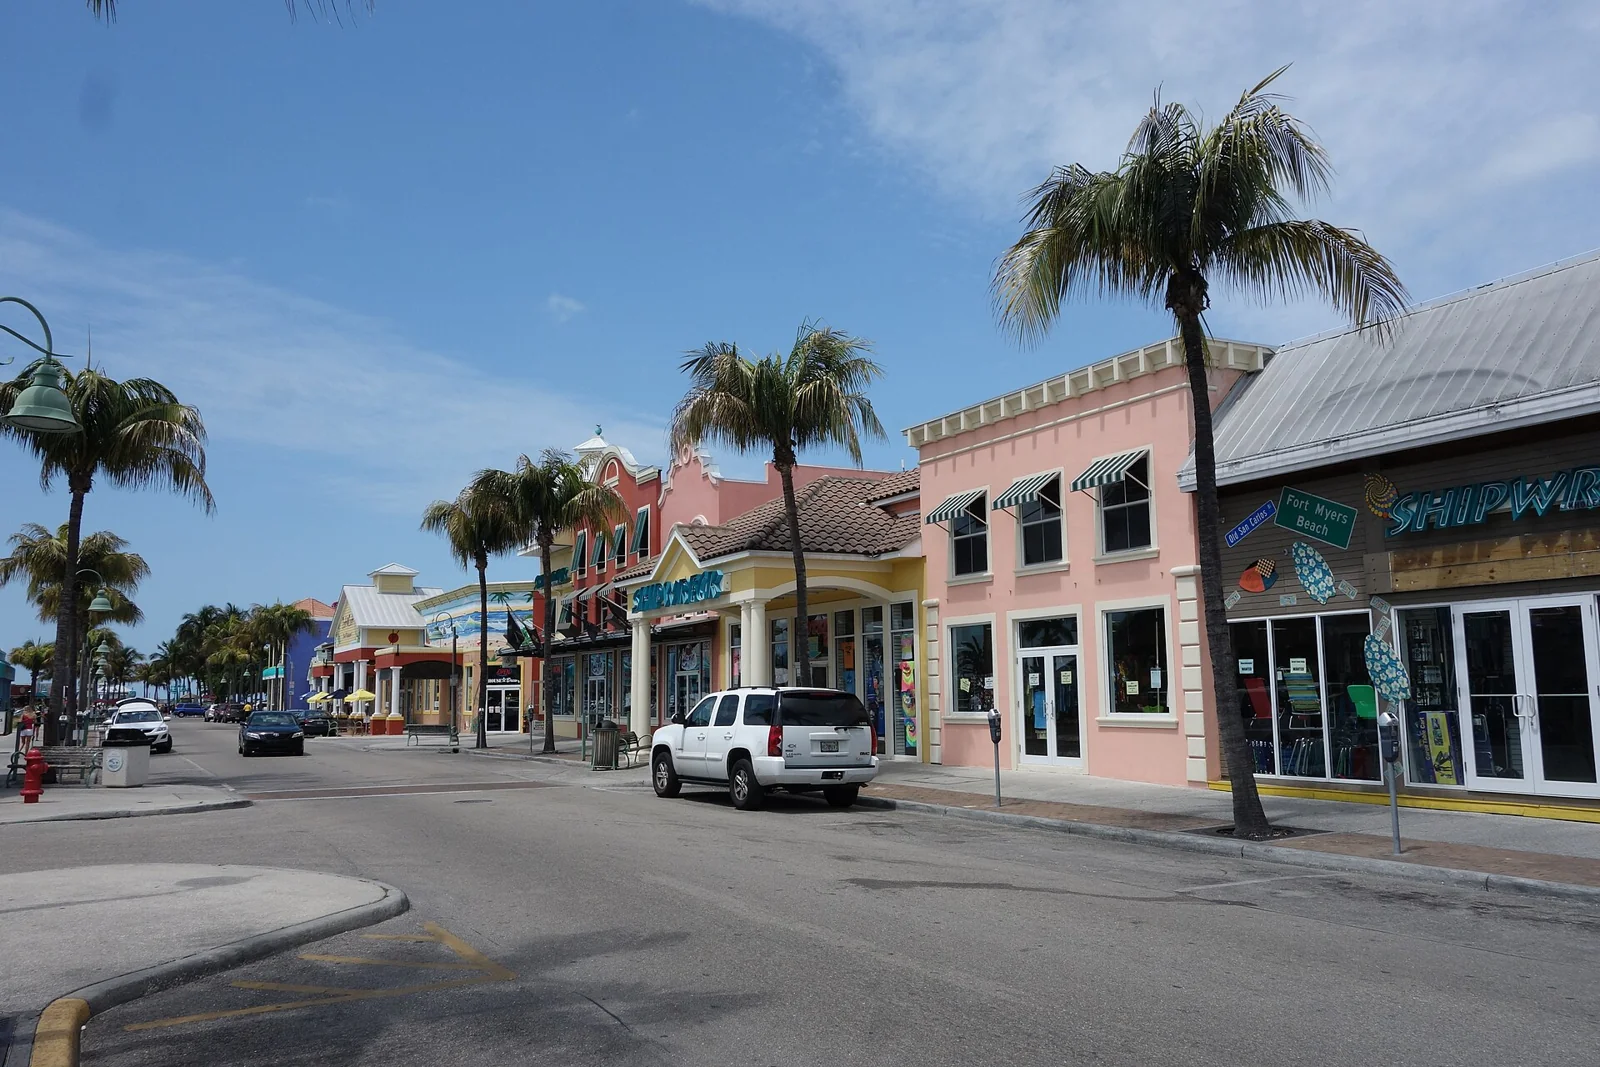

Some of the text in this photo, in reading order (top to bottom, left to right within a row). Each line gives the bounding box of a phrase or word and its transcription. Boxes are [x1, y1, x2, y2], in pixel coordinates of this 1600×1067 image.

[1286, 494, 1349, 525] Fort Myers
[1228, 533, 1239, 543] Old
[1238, 525, 1250, 536] San
[1249, 509, 1268, 527] Carlos
[1296, 515, 1329, 536] Beach
